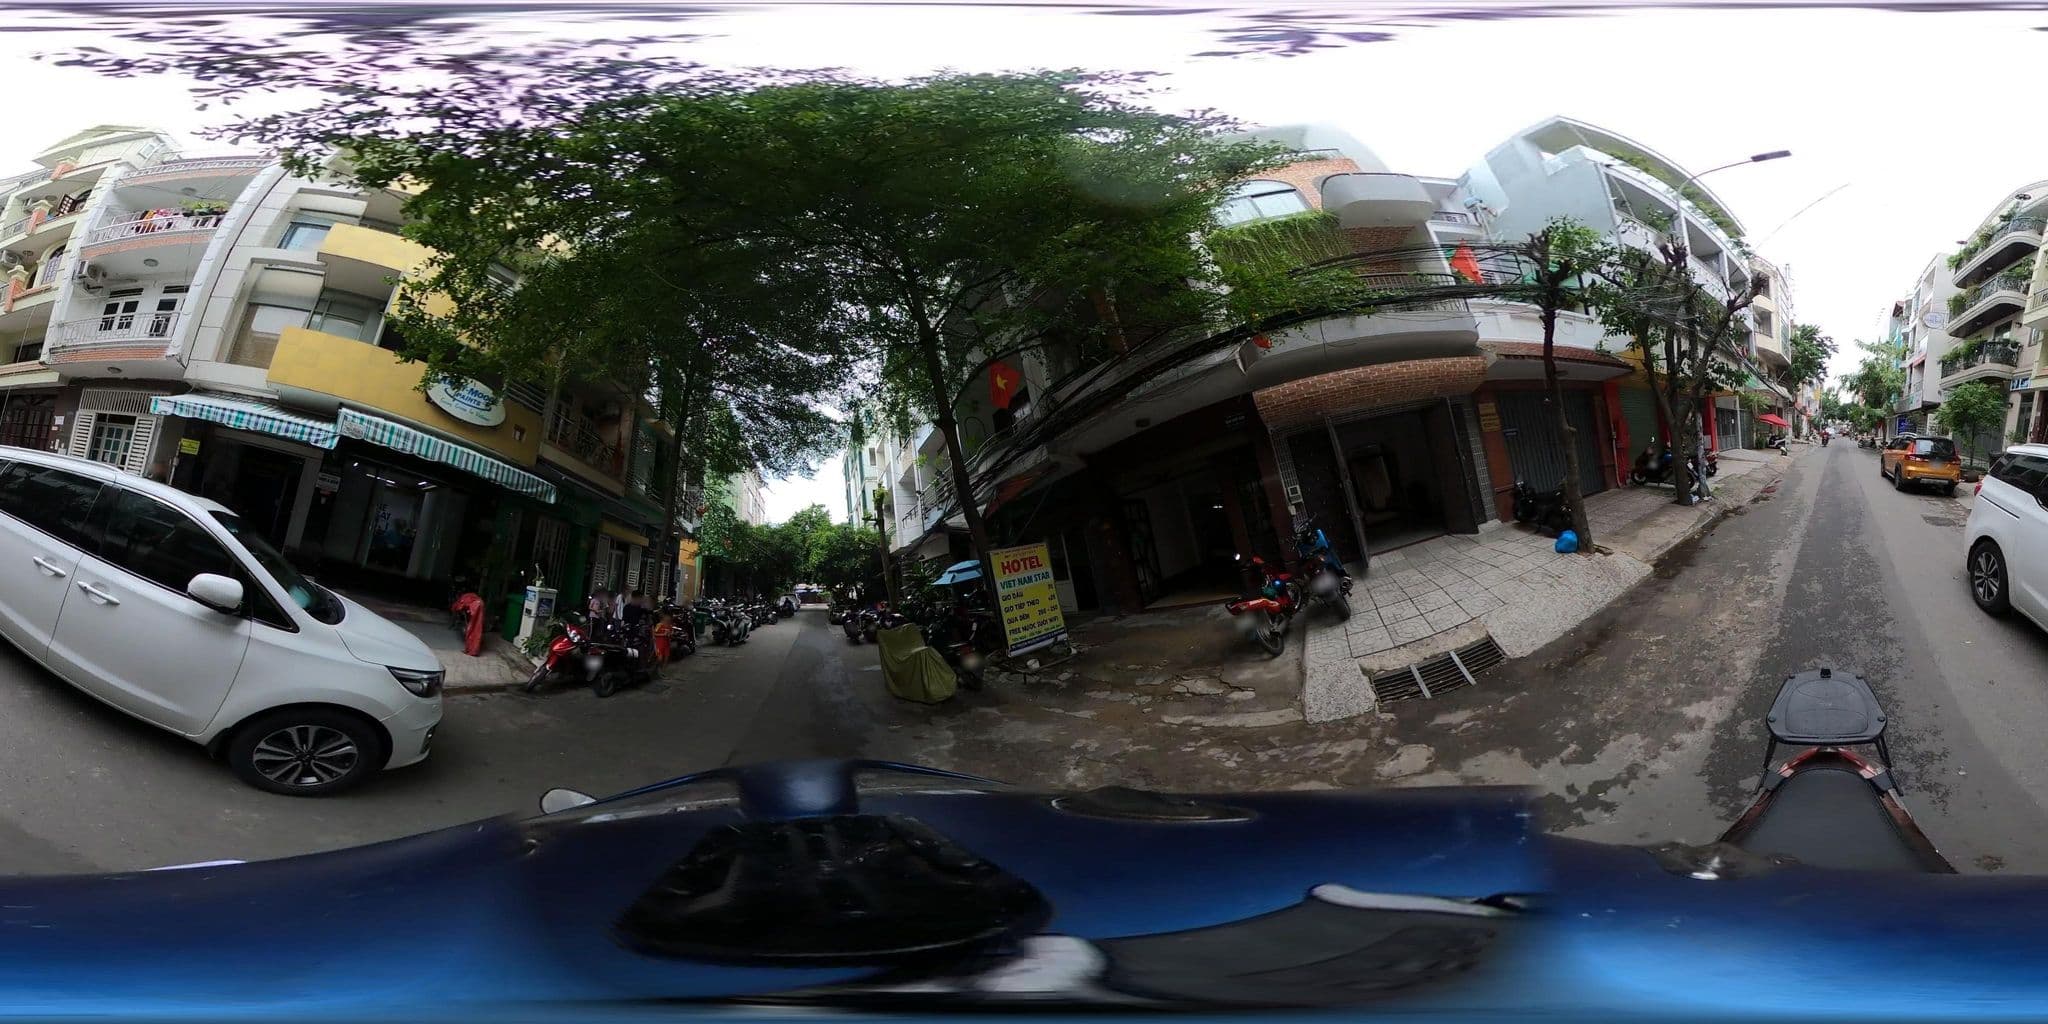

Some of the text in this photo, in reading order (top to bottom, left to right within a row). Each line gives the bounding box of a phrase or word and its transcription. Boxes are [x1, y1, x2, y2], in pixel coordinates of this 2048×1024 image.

[1001, 556, 1042, 574] HOTEL
[1019, 575, 1034, 586] NAM
[1033, 571, 1051, 582] STAR
[1009, 627, 1022, 636] FREE
